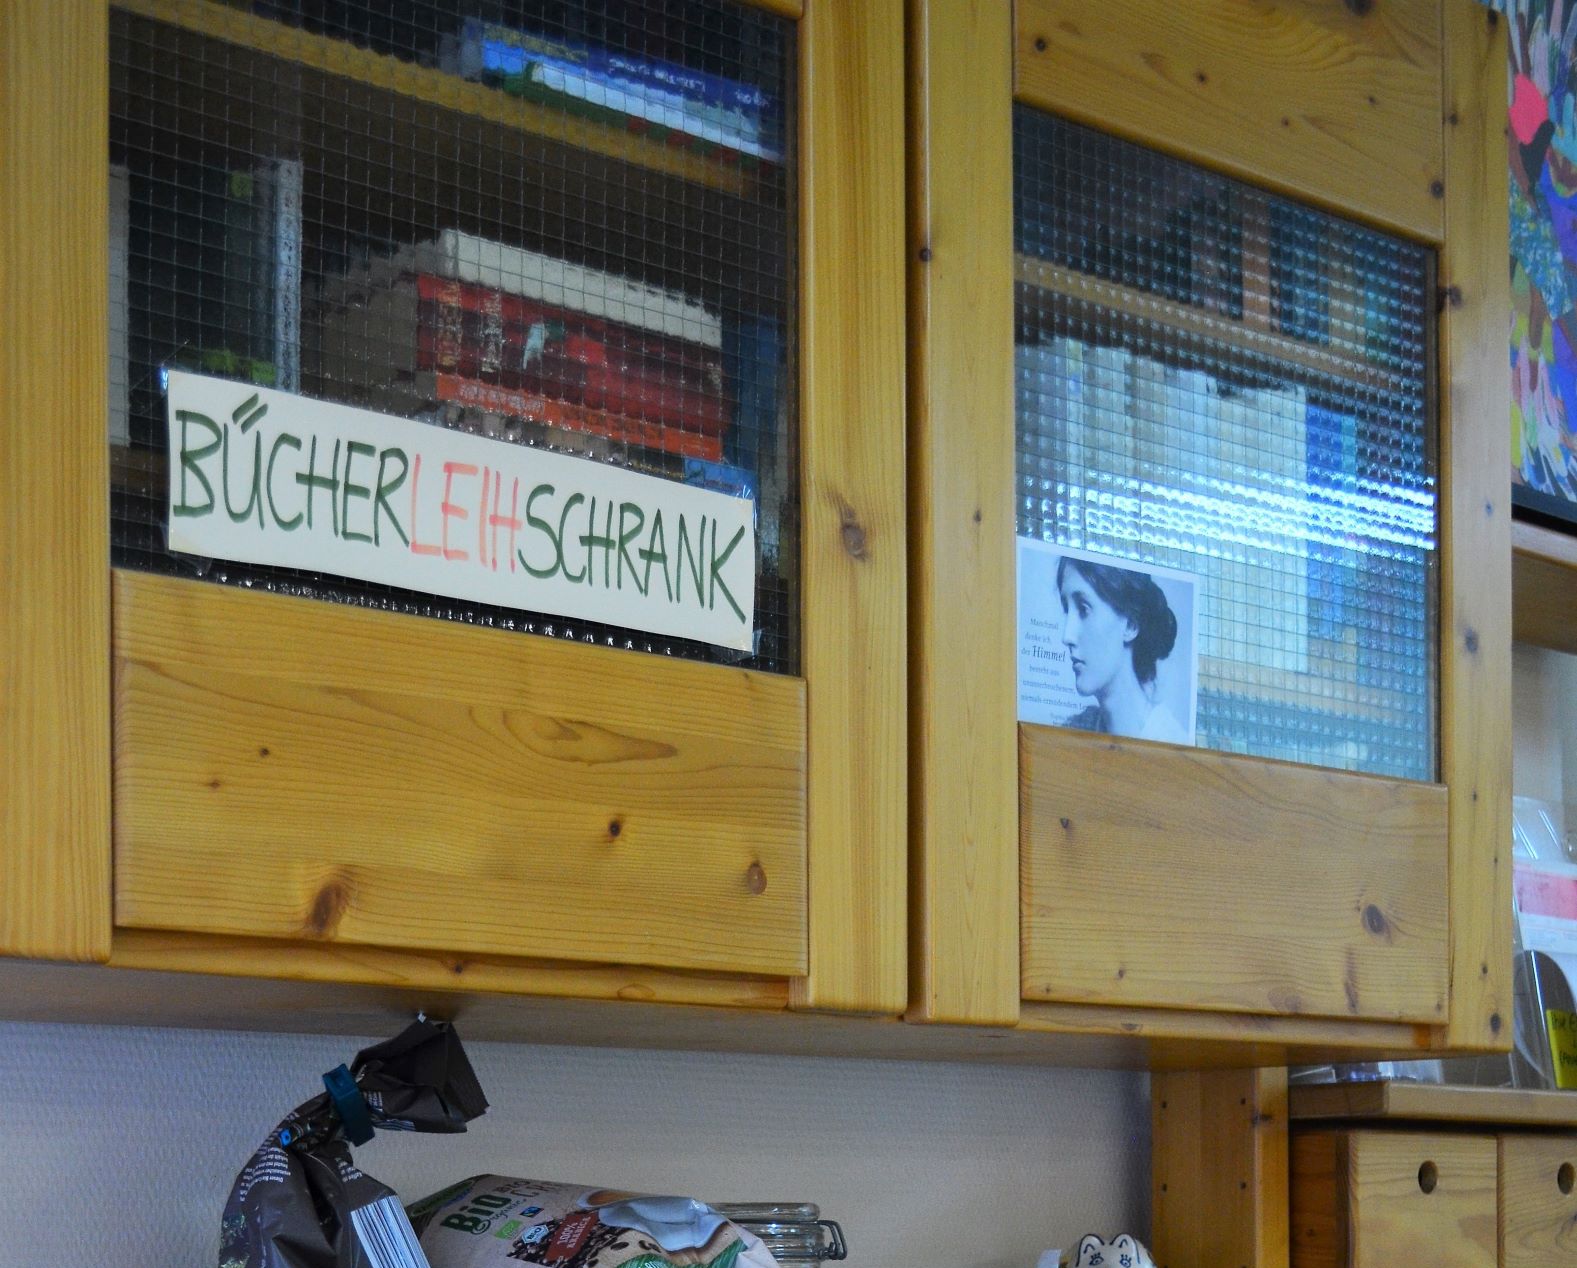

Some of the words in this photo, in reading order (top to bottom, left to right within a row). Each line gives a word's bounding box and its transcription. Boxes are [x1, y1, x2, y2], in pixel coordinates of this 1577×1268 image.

[1032, 645, 1066, 662] Himmel
[557, 1222, 579, 1246] 100%
[567, 1216, 592, 1249] ARABICA
